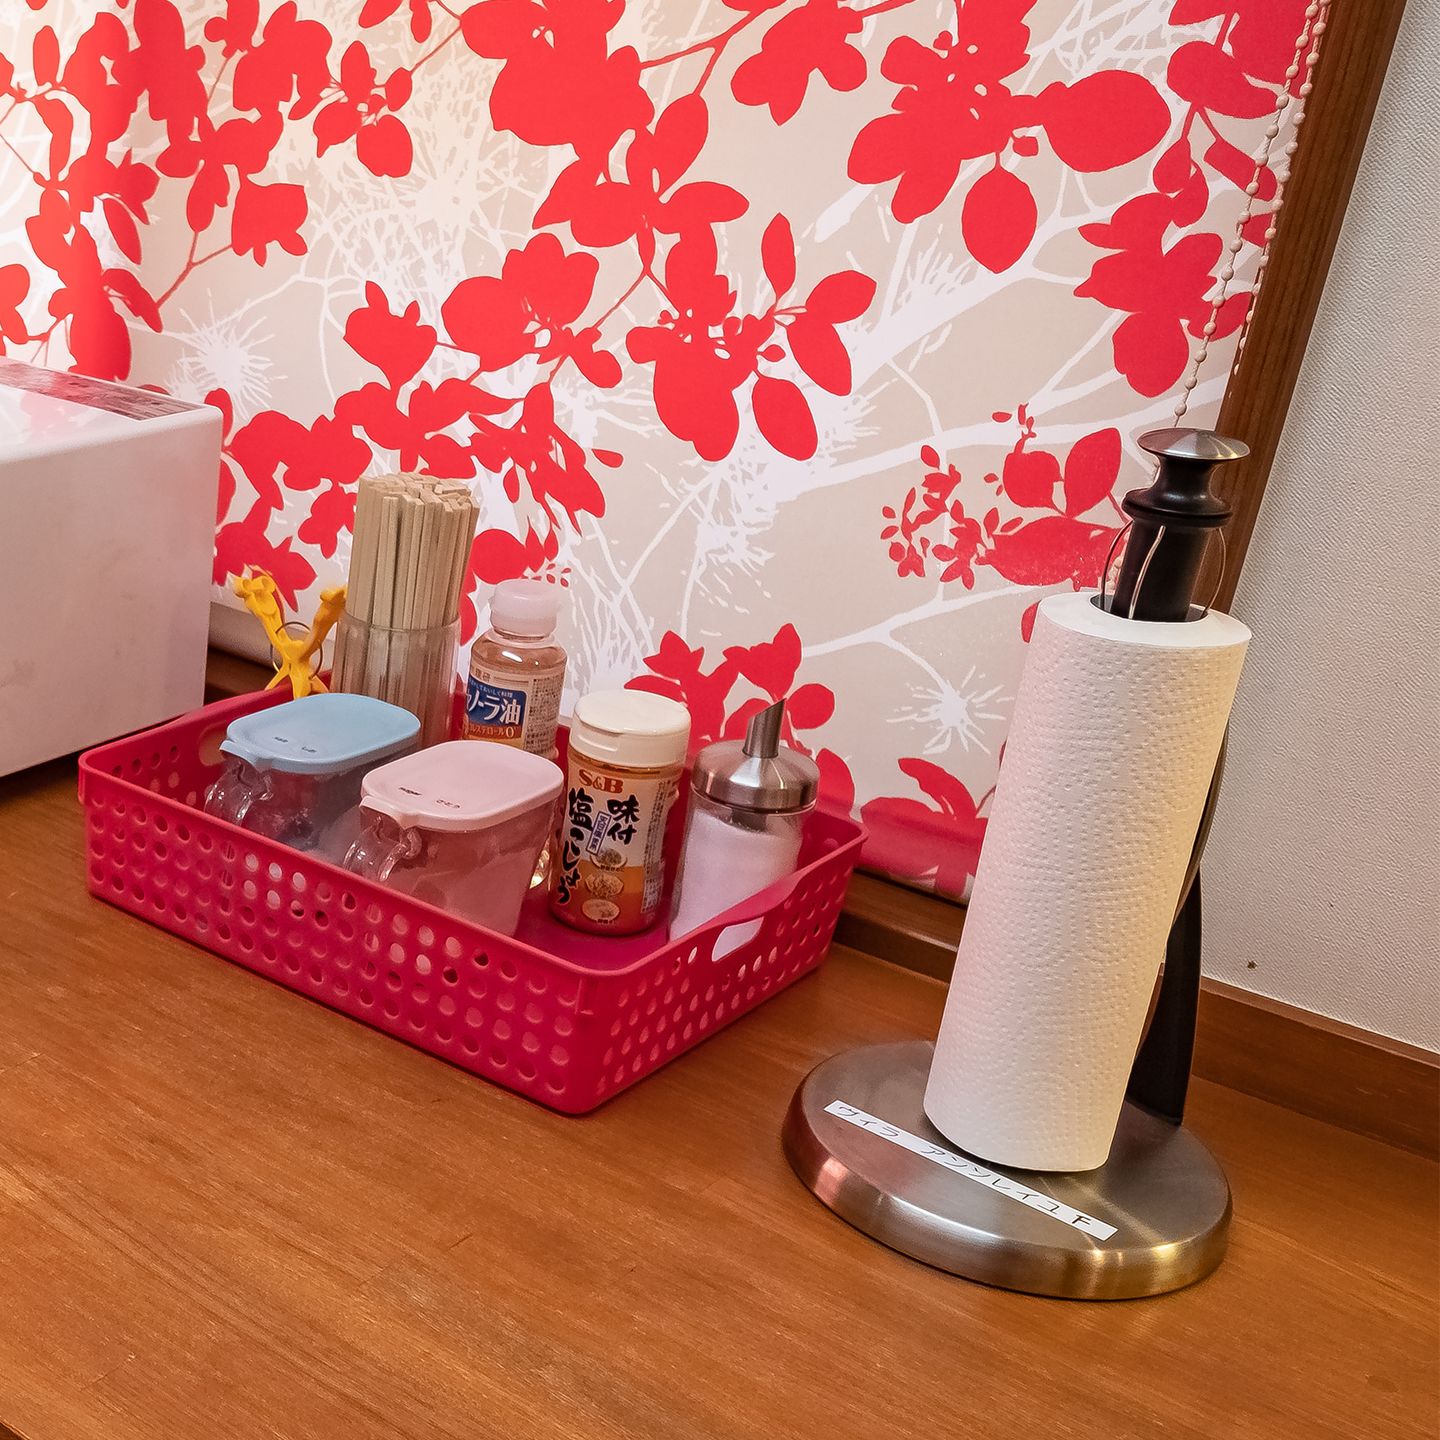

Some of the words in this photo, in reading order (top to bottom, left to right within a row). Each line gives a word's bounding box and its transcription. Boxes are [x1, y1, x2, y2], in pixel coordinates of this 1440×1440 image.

[578, 768, 624, 794] S&B
[606, 794, 640, 845] 味付
[557, 787, 594, 904] 塩こしょう
